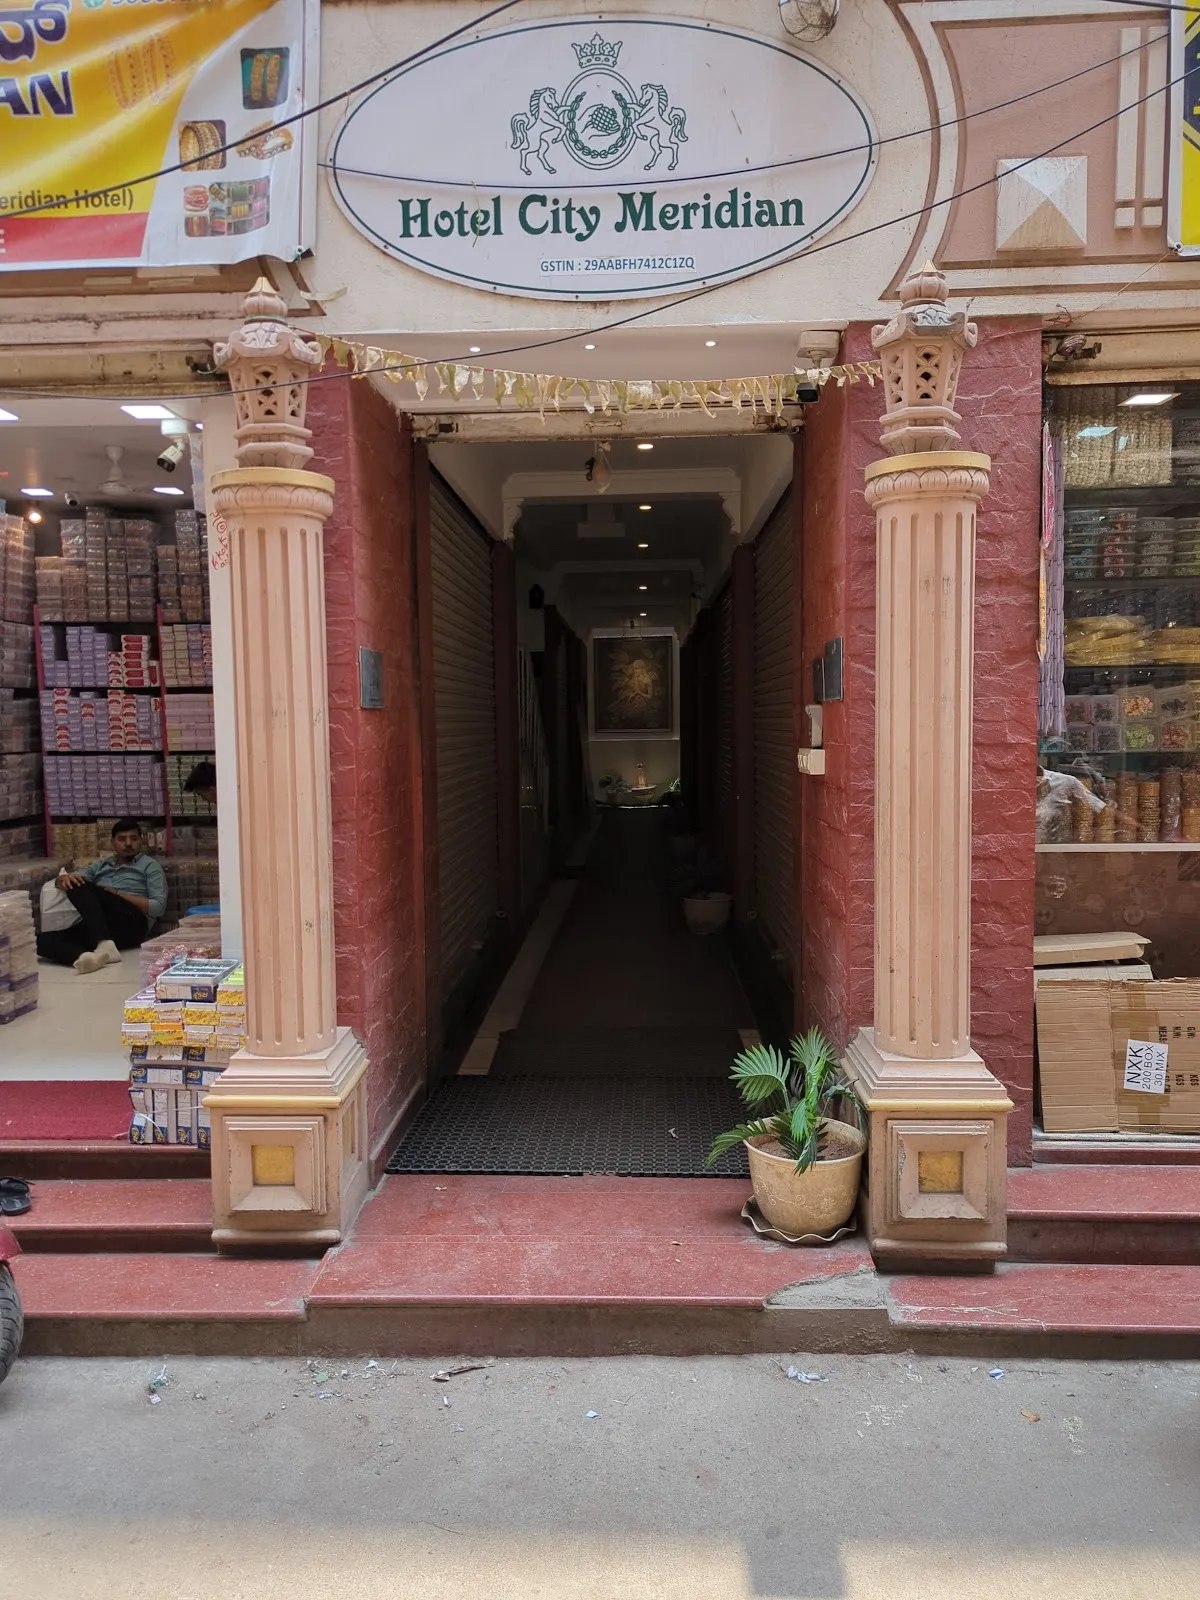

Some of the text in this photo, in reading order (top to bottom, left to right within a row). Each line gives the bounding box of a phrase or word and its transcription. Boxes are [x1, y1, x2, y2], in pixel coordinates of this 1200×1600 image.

[398, 187, 805, 242] Hotel City Meridian
[540, 260, 574, 272] GSTIN
[584, 257, 695, 272] 29AABFH7412C1ZQ
[1126, 1046, 1144, 1084] NXK
[1142, 1045, 1154, 1090] 200 BOX
[1153, 1051, 1166, 1087] 30 MIX
